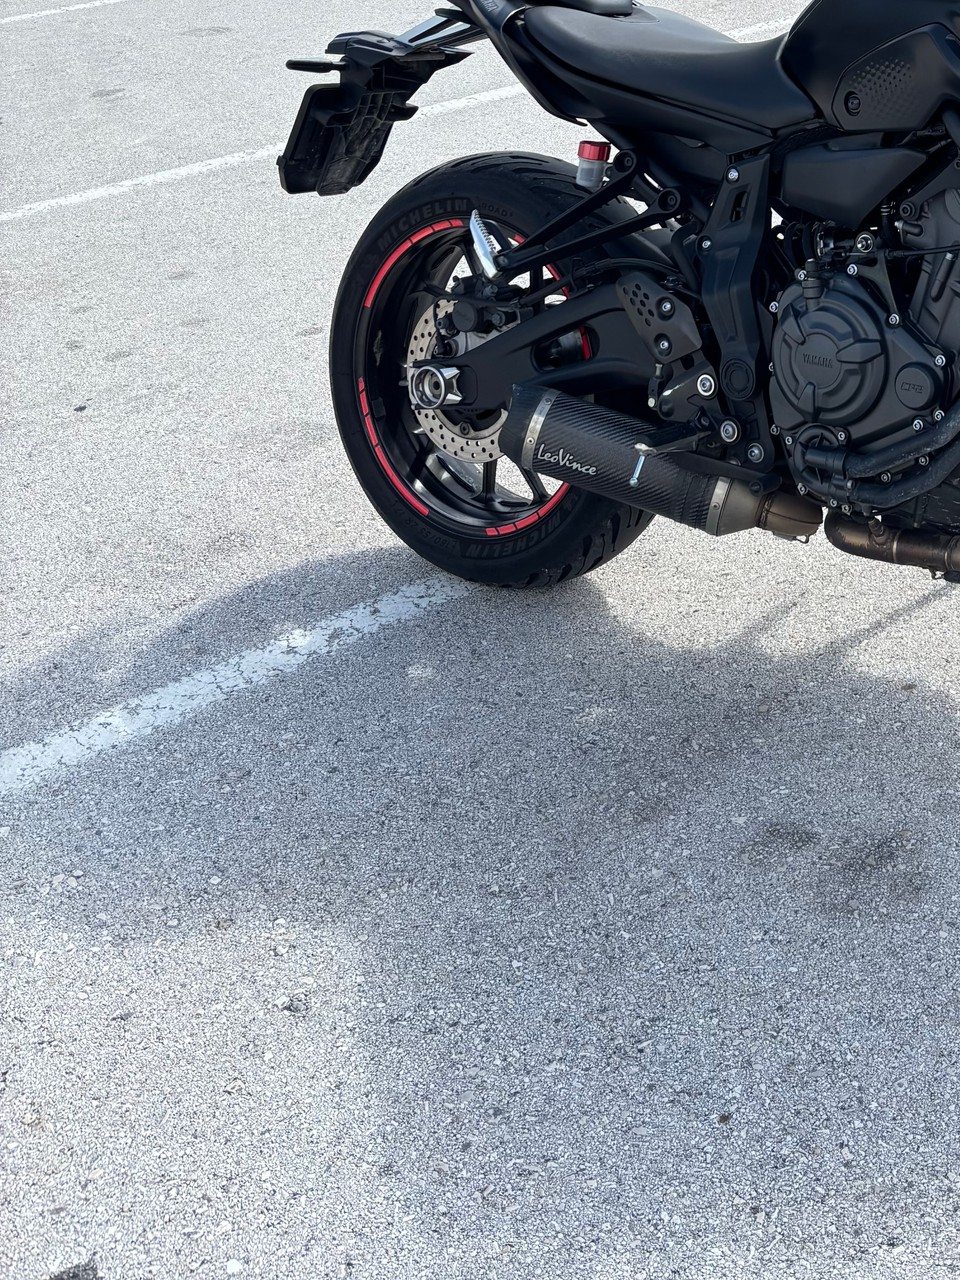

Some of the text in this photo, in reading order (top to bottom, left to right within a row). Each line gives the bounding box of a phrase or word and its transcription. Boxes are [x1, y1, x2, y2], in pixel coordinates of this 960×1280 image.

[376, 198, 468, 252] MICHELIN
[802, 352, 834, 369] YAMAHA
[537, 443, 597, 476] LeoVince
[465, 511, 561, 558] MICHELIN
